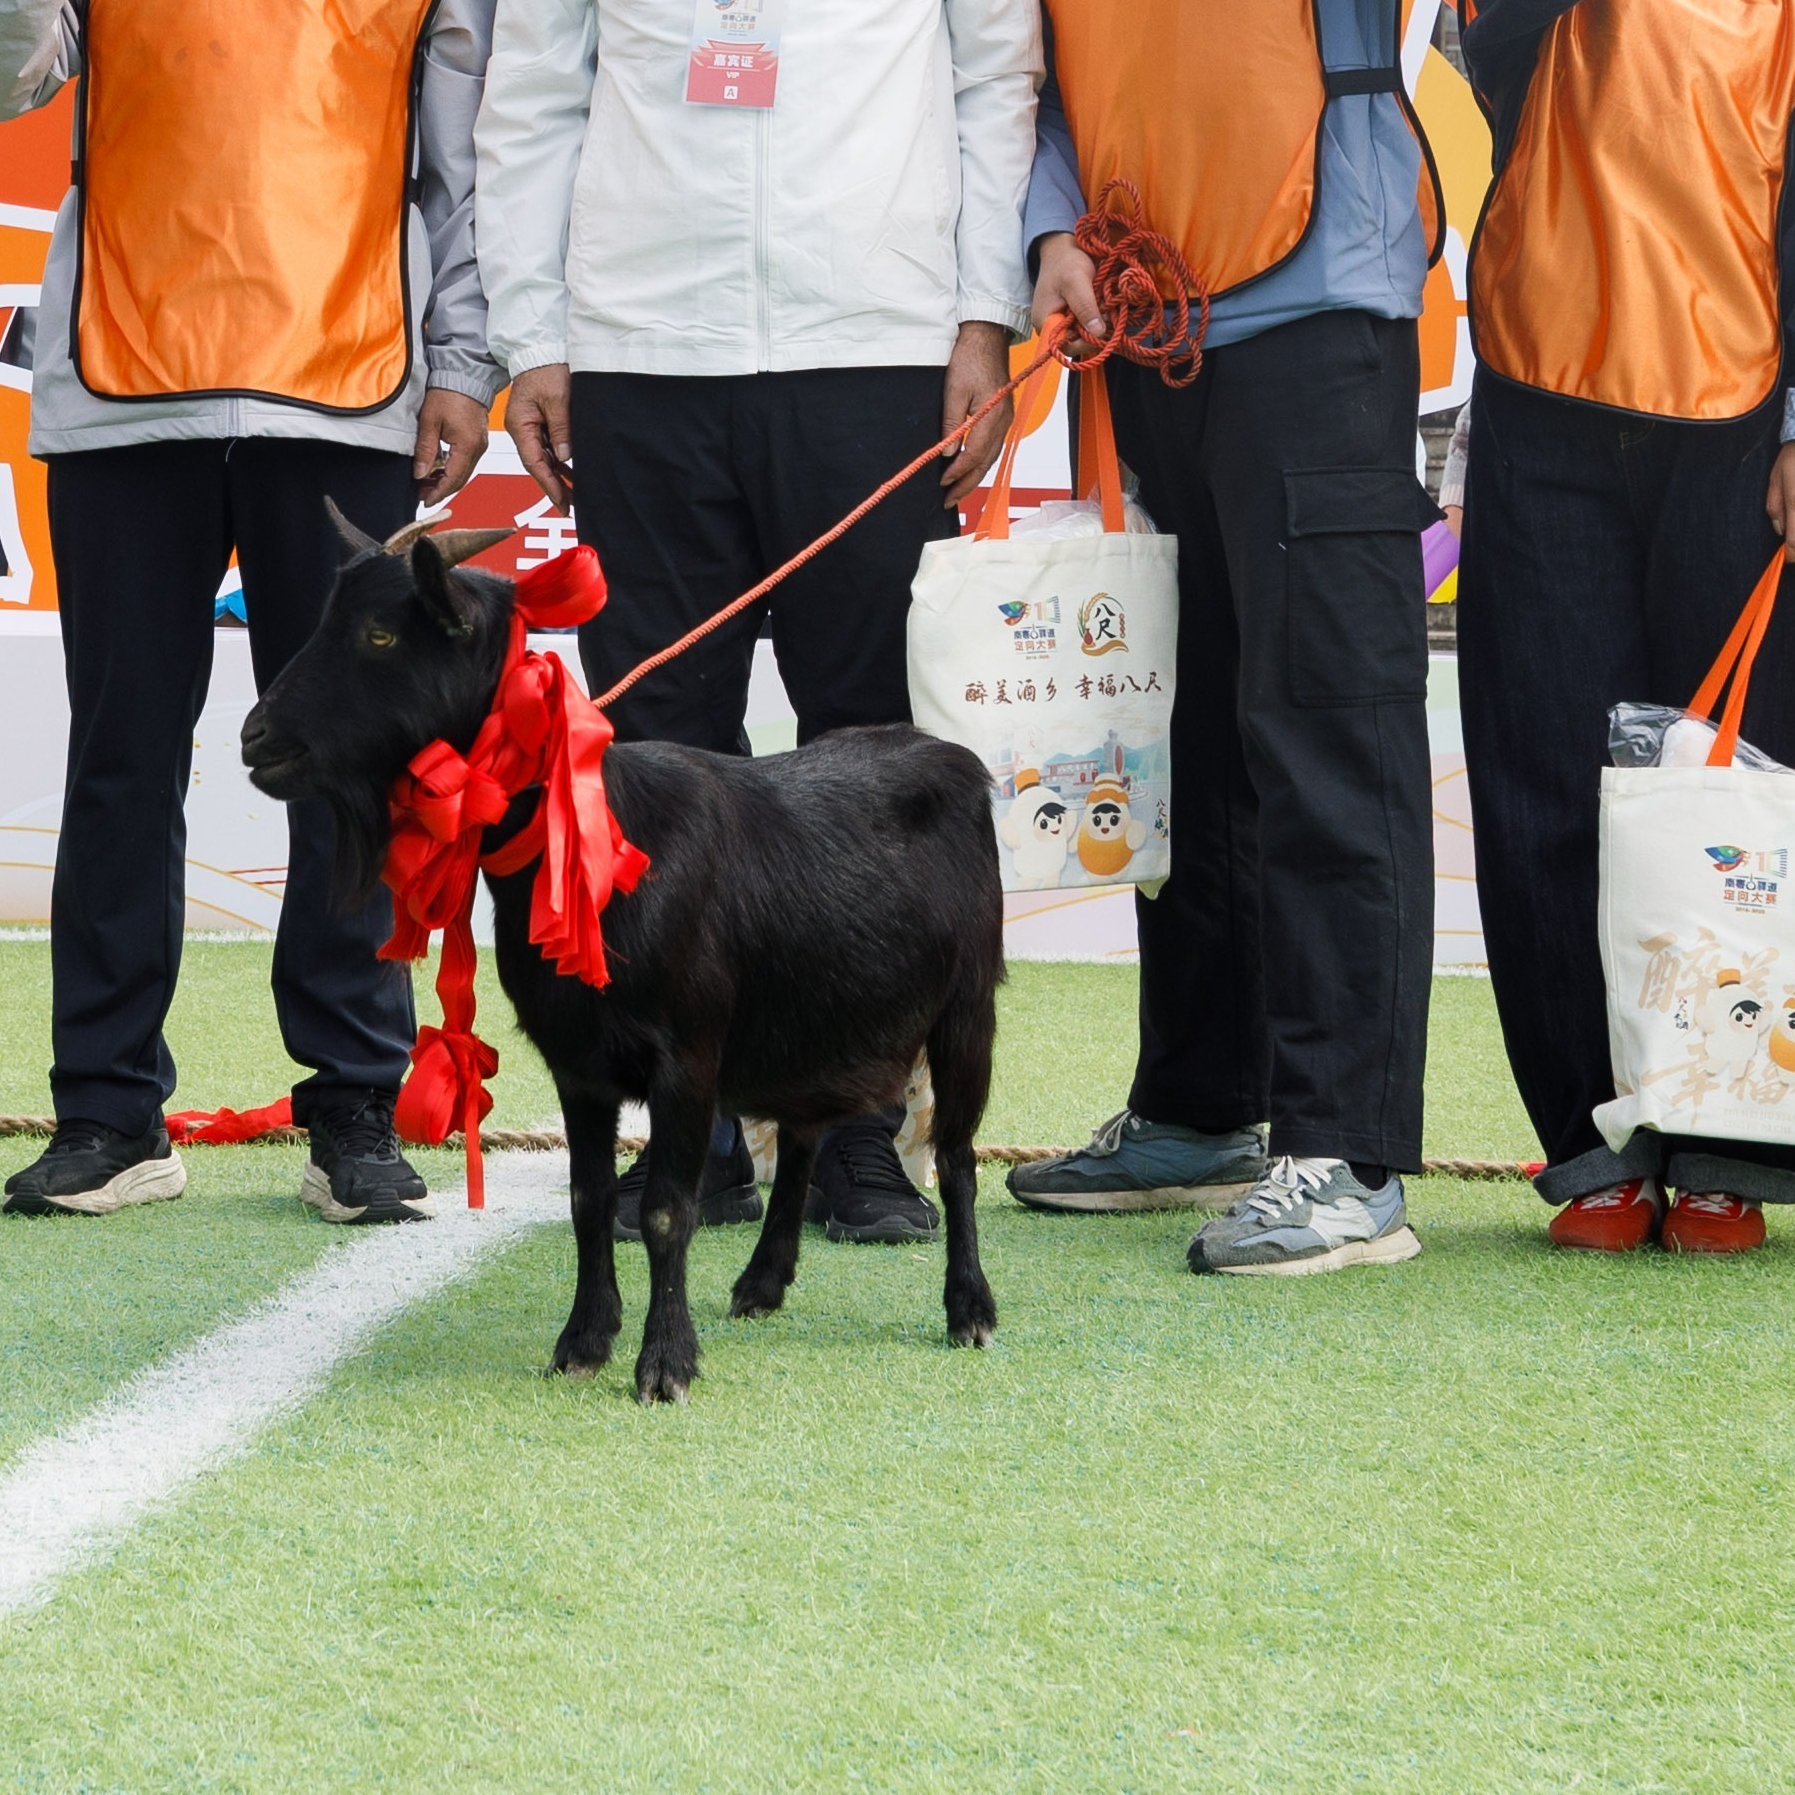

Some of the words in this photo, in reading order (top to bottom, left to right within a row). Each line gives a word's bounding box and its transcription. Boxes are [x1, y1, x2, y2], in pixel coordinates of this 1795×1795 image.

[726, 71, 740, 79] VIP
[727, 88, 736, 98] A
[1094, 603, 1117, 640] 八尺
[965, 677, 1058, 705] 醉美酒乡
[1075, 671, 1162, 700] 幸福八尺
[1723, 890, 1777, 904] 定向大赛
